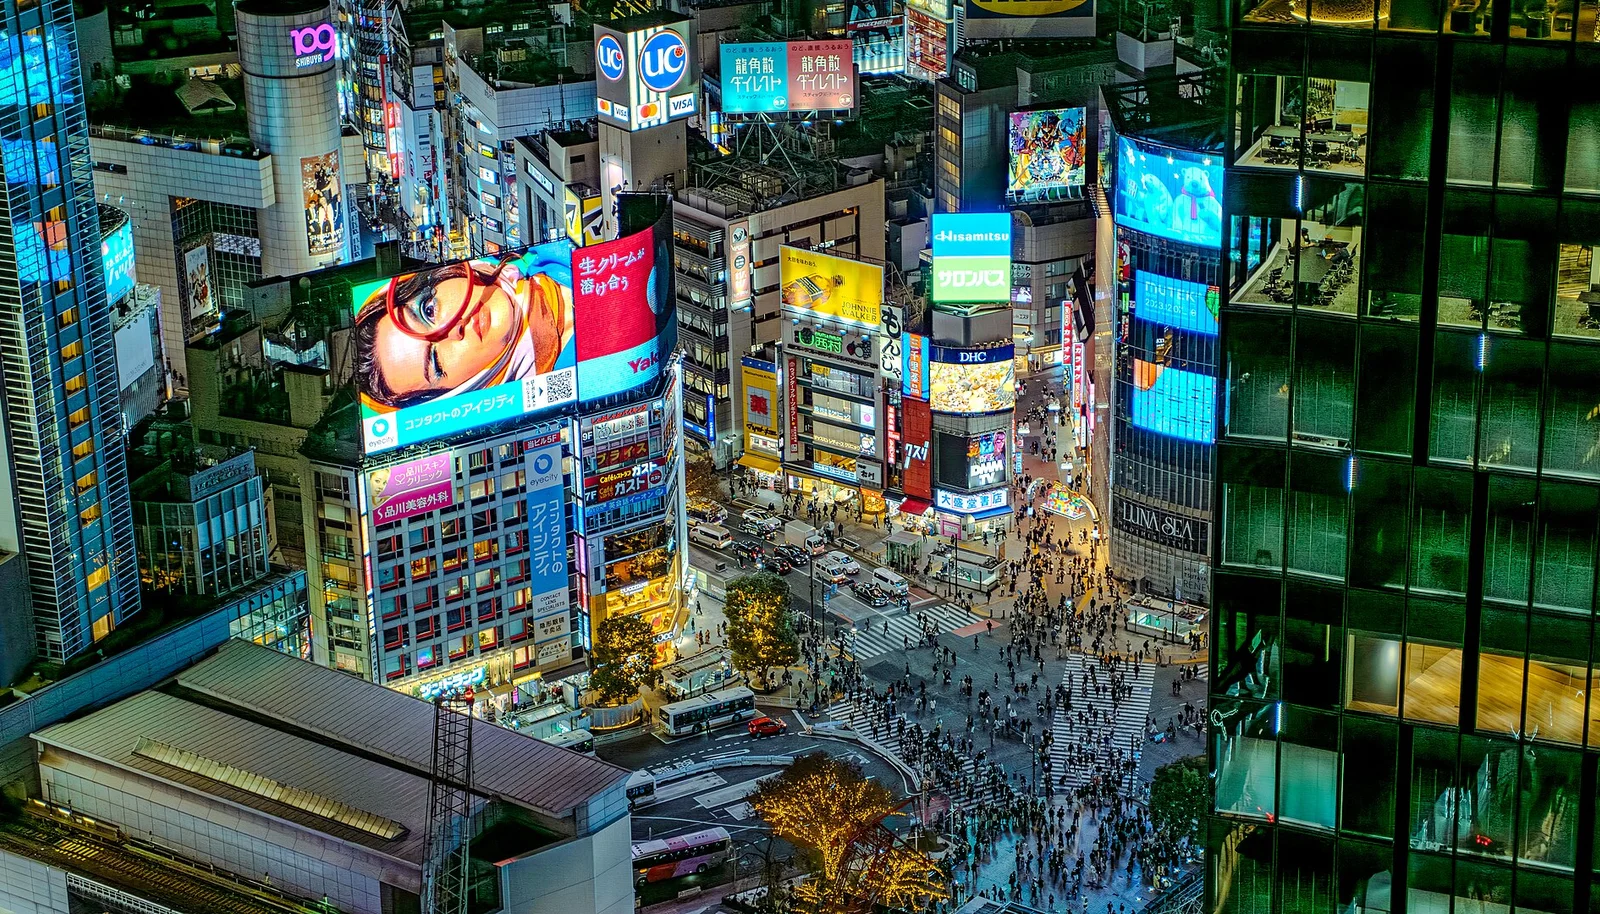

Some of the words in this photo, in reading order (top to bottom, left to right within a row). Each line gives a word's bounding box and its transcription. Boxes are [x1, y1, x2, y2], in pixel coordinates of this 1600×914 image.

[857, 20, 893, 28] SKECHERS
[291, 24, 334, 61] 109
[296, 54, 323, 67] SHIBUYA
[600, 46, 622, 70] UC
[644, 44, 684, 77] UC
[735, 57, 774, 75] 龍角散
[801, 54, 840, 73] 龍角散
[730, 75, 782, 93] ダイレクト
[796, 73, 848, 91] ダイレクト
[616, 108, 626, 116] VISA
[672, 98, 692, 111] VISA
[934, 230, 1009, 242] Hisamitsu
[578, 248, 645, 276] 生クリームが
[580, 274, 629, 297] 溶け合う
[938, 270, 1006, 287] サロンパス
[841, 301, 877, 315] JOHNNIE
[841, 308, 877, 323] WALKER
[960, 351, 987, 362] DHC
[404, 394, 516, 431] コンタクトのアイシティ
[582, 431, 592, 441] 9F
[406, 459, 447, 477] 品川スキン
[632, 461, 657, 477] ガスト
[971, 460, 1003, 476] DMM
[407, 469, 443, 486] クリニック
[530, 472, 559, 487] eyecity
[979, 472, 995, 485] TV
[615, 477, 645, 497] ガスト
[384, 490, 449, 518] 品川美容外科
[584, 490, 598, 502] 7F
[941, 492, 1003, 509] 大盛堂書店
[1123, 502, 1160, 532] LUNA
[1161, 517, 1196, 541] SEA
[531, 502, 550, 577] アイシティ
[549, 499, 563, 573] コンタクトの
